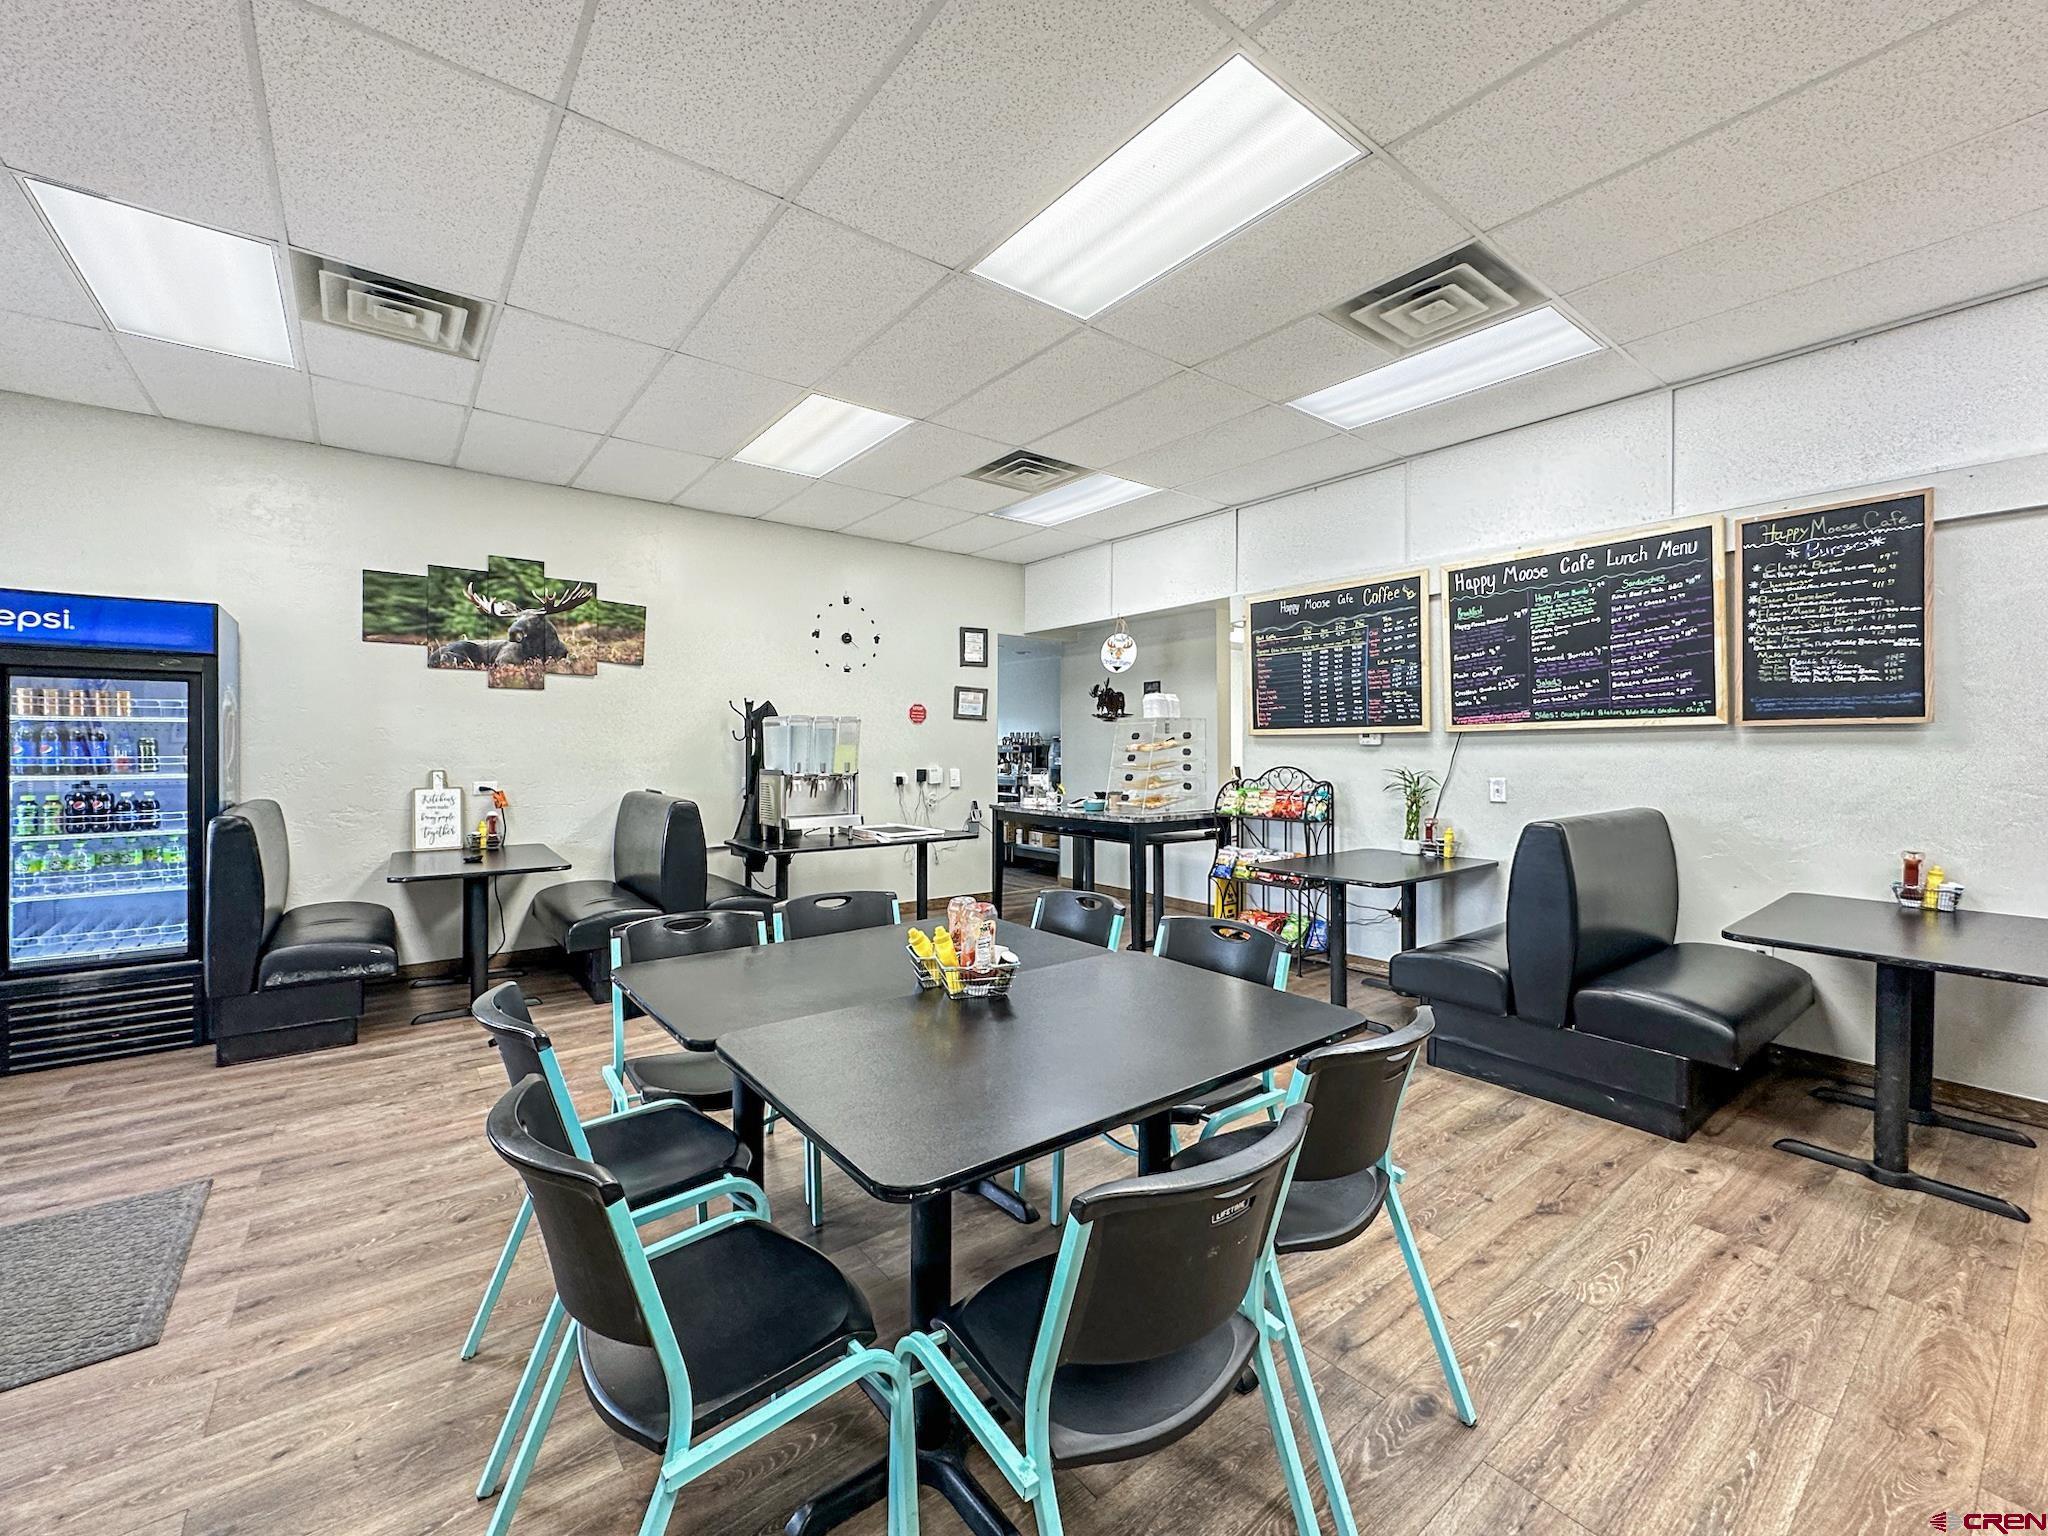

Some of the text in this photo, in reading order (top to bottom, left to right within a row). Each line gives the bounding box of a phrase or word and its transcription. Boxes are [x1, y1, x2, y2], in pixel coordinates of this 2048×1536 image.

[1760, 510, 1908, 543] Happy Moose Cafe
[1455, 540, 1698, 595] Happy Moose Cafe Lunch Menu
[1622, 575, 1666, 589] Sandwiches
[1280, 586, 1400, 615] Happy Moose Cafe Coffee
